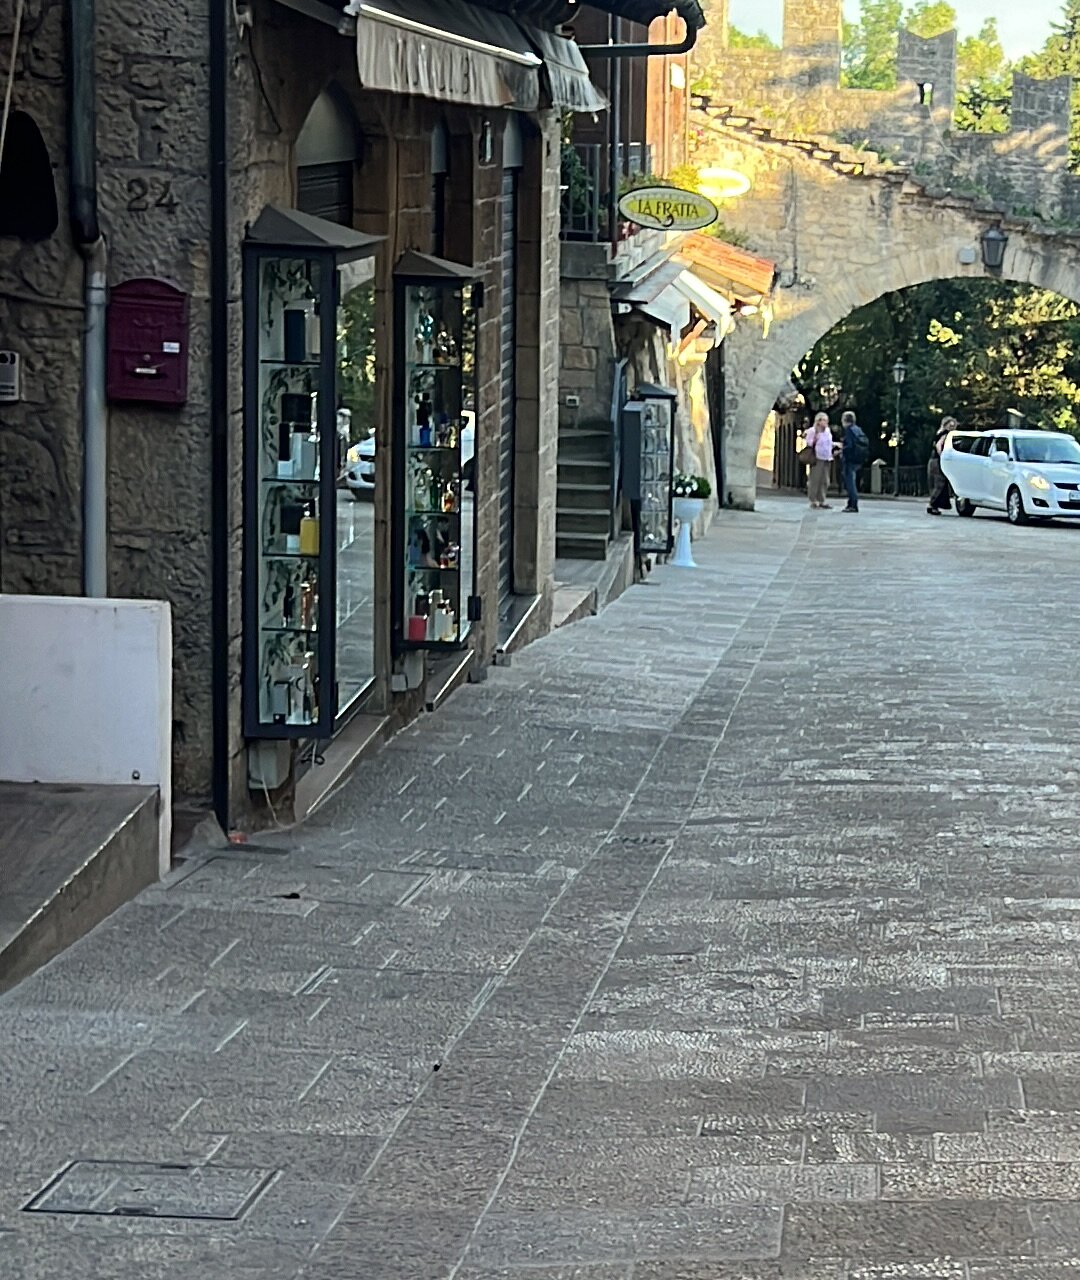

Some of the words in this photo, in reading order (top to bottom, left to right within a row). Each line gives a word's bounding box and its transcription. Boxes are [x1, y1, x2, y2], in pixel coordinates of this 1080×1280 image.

[126, 176, 180, 215] 24
[637, 199, 653, 216] LA
[655, 201, 700, 218] FRATTA
